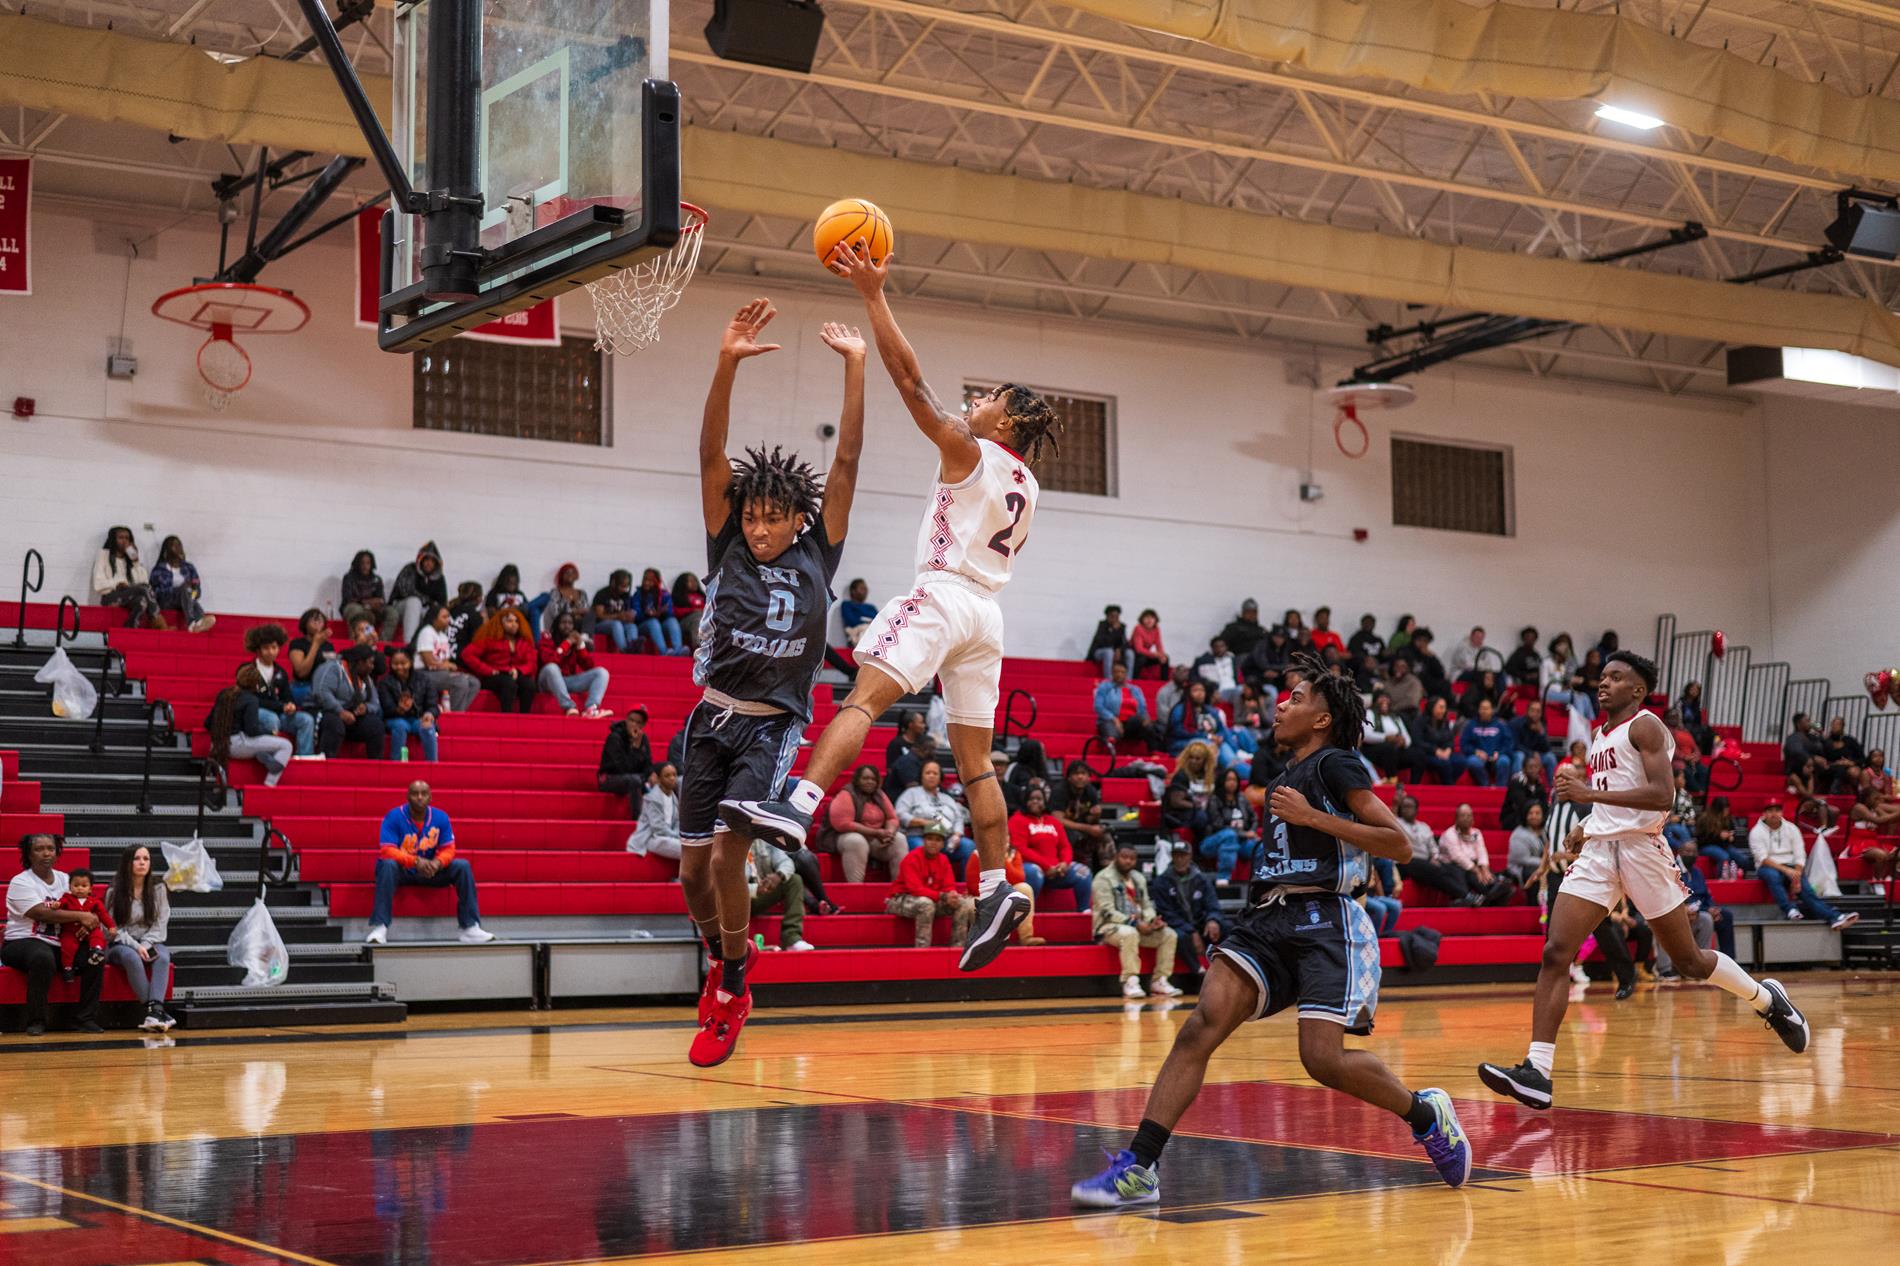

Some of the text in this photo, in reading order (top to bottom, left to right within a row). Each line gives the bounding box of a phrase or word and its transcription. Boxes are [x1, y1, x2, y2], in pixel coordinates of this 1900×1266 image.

[0, 237, 20, 253] LL
[987, 491, 1028, 559] 2
[765, 589, 795, 632] 0
[1267, 822, 1292, 860] 3
